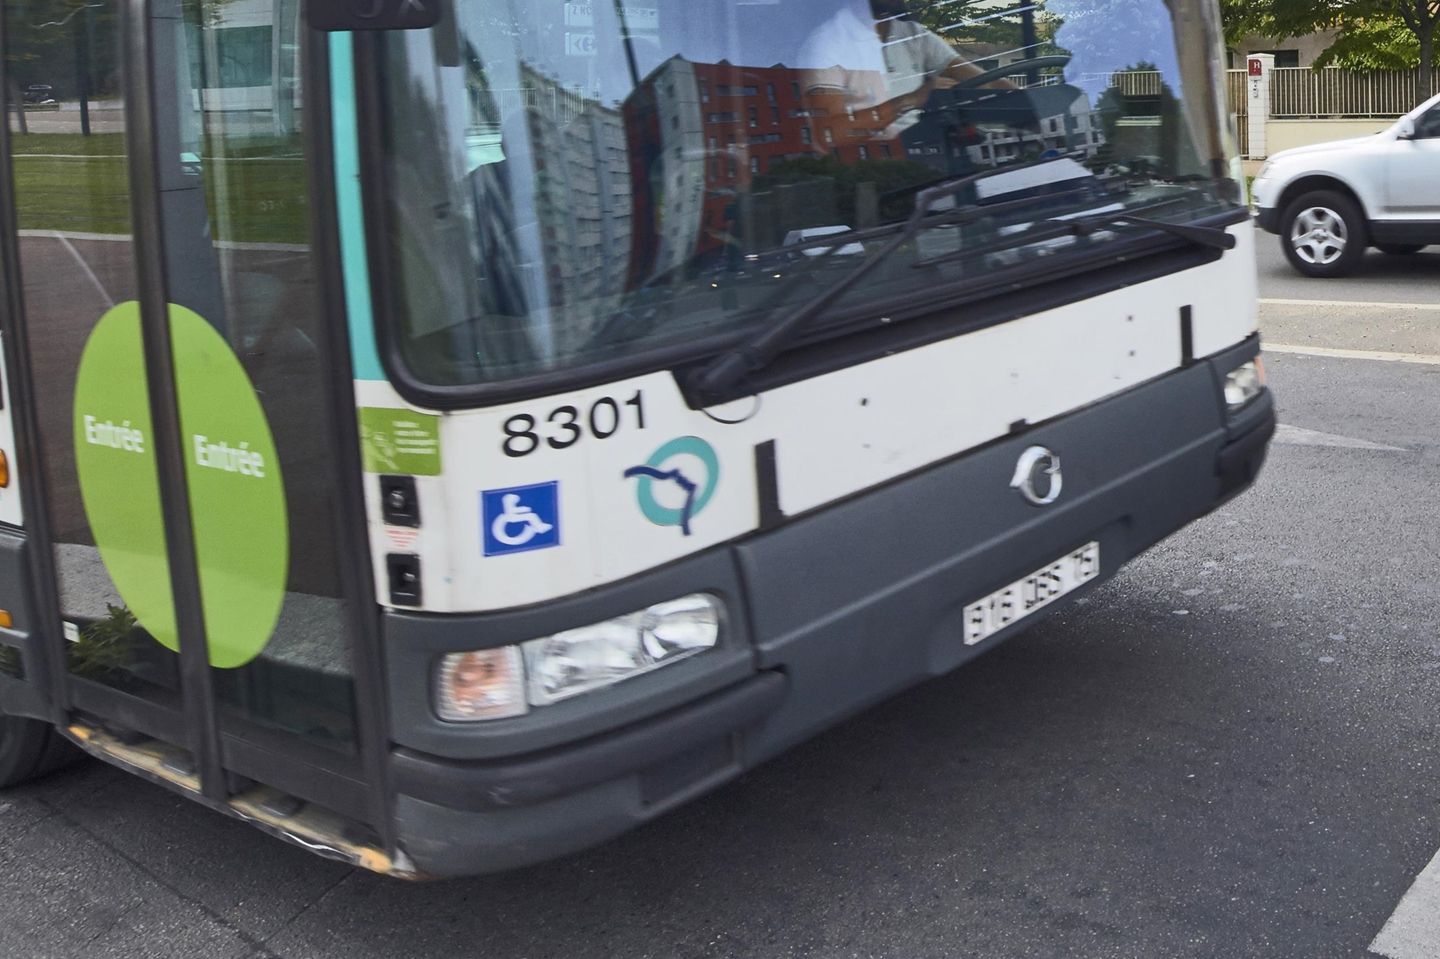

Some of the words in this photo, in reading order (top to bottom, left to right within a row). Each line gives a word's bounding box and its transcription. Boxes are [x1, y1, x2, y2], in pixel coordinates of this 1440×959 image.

[83, 414, 145, 454] Entrée
[502, 389, 646, 458] 8301
[193, 434, 265, 478] Entrée
